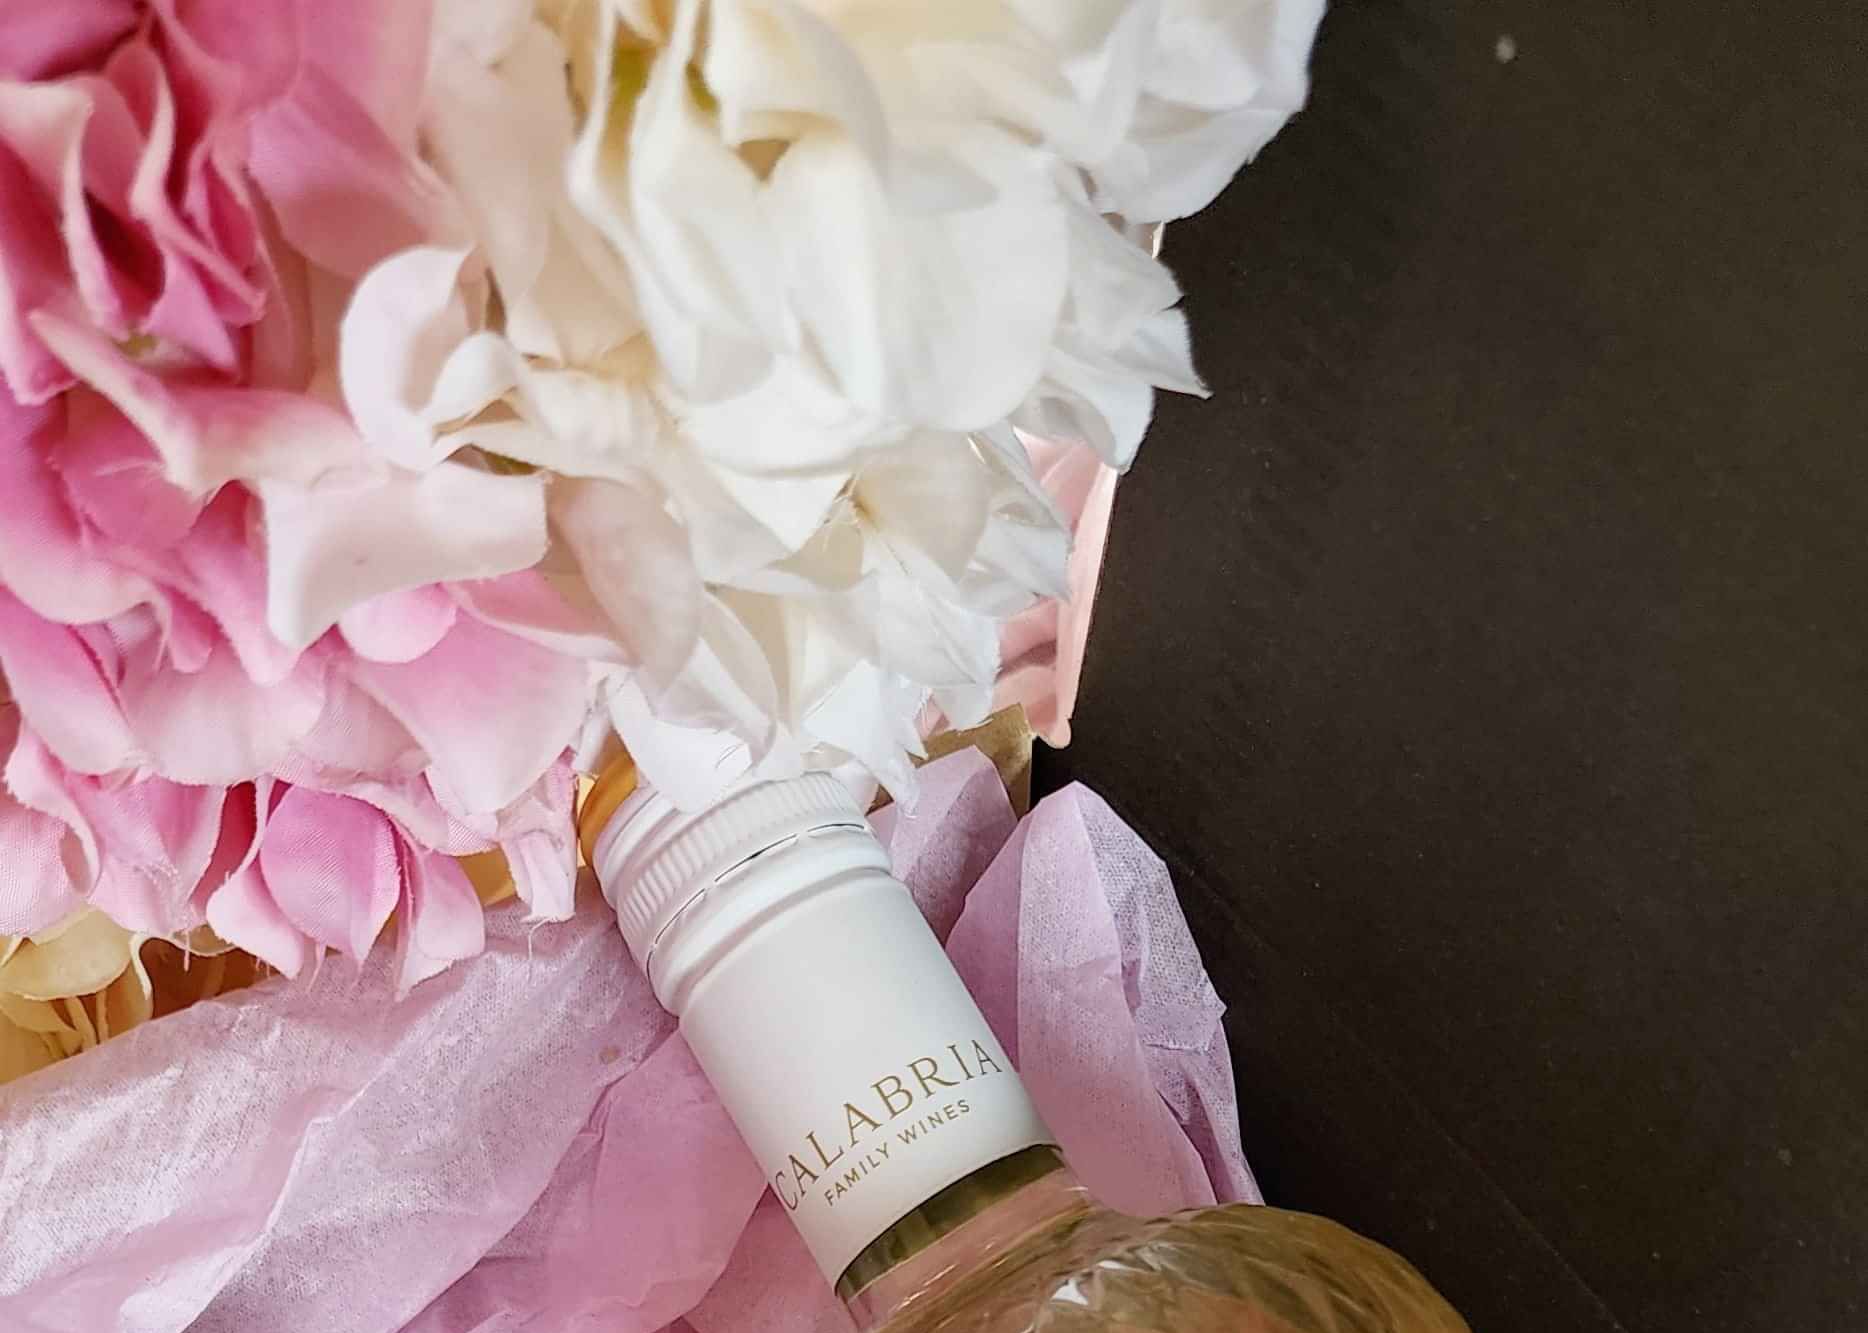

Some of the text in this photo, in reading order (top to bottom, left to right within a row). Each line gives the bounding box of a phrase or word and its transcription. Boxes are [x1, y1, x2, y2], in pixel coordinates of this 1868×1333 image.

[773, 1039, 1003, 1212] CALABRIA
[824, 1099, 970, 1206] FAMILY WINES
